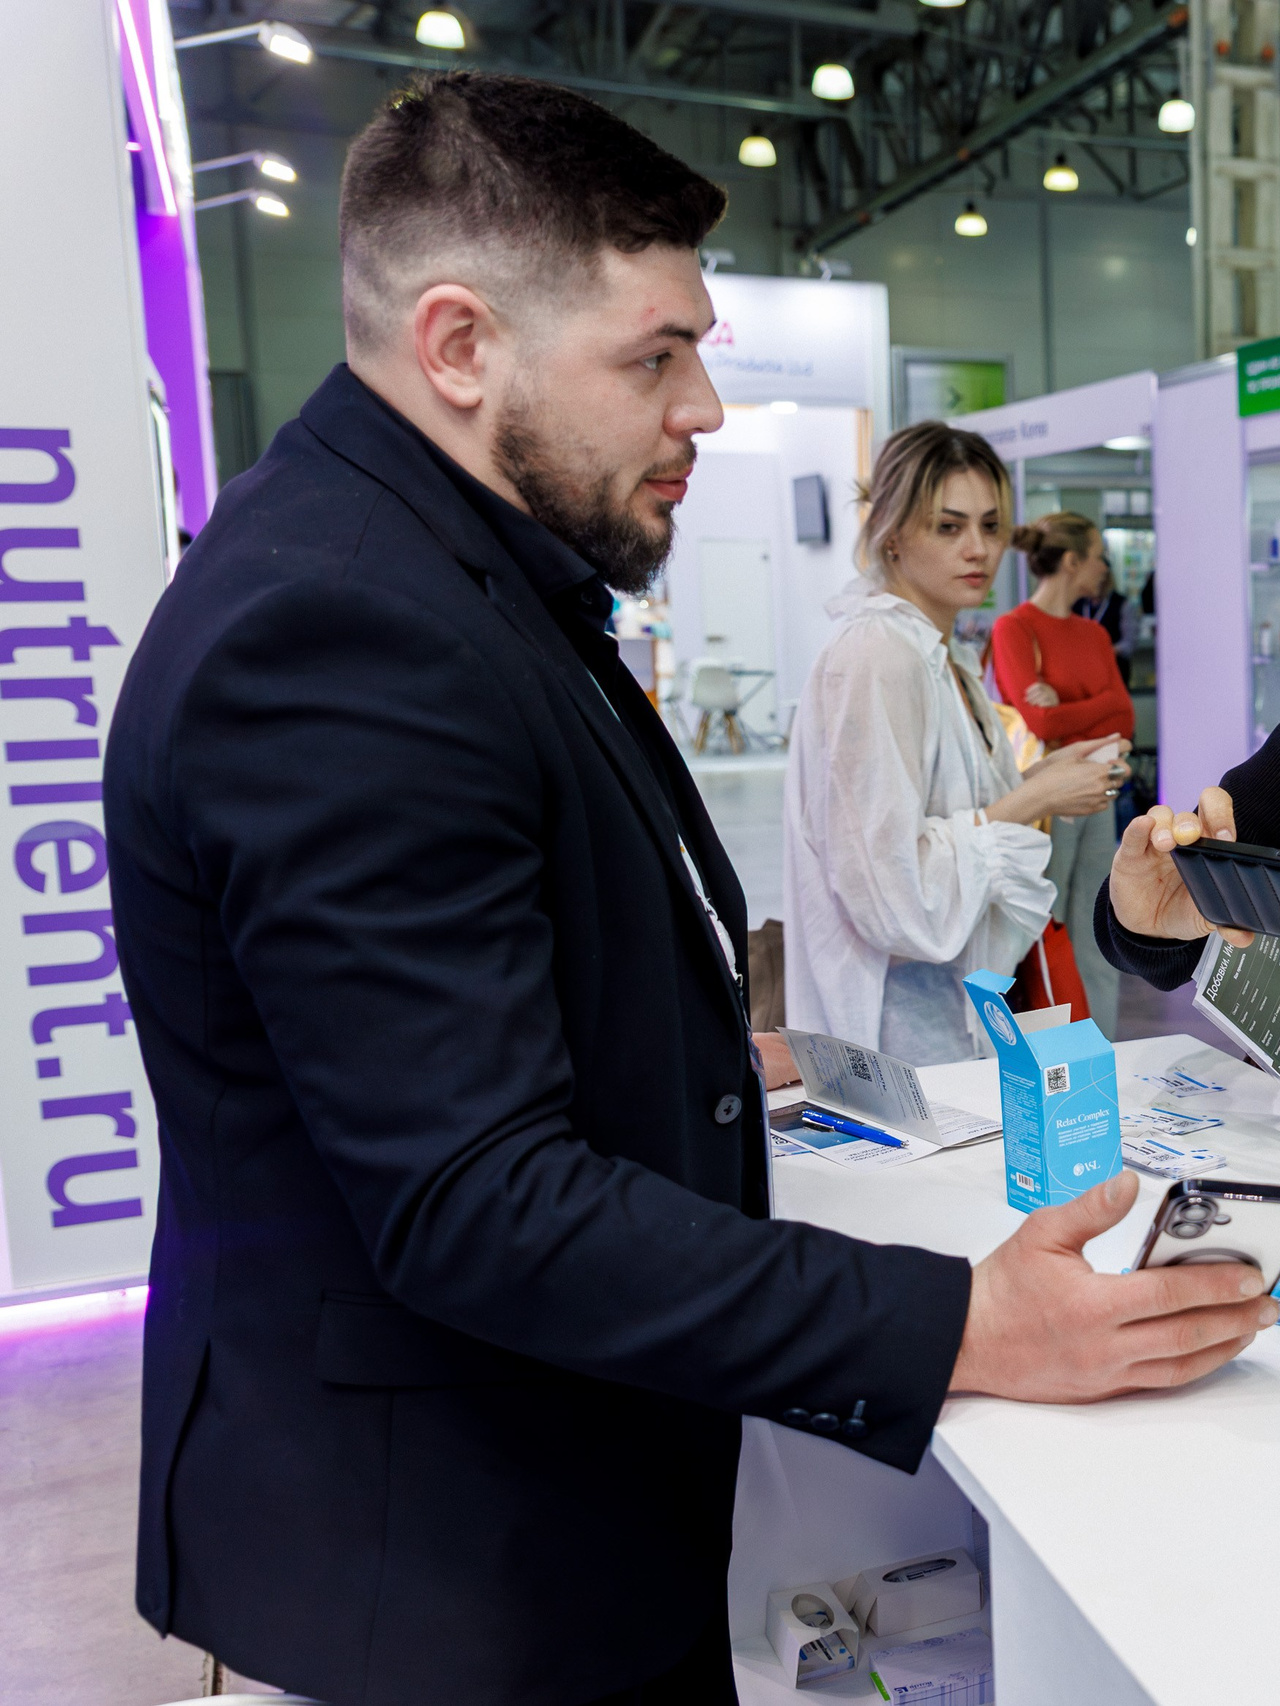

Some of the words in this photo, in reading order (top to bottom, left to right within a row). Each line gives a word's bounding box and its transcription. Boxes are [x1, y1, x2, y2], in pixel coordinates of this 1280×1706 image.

[1226, 942, 1235, 960] Ин
[1056, 1117, 1077, 1129] Relax
[1077, 1109, 1110, 1123] Complex
